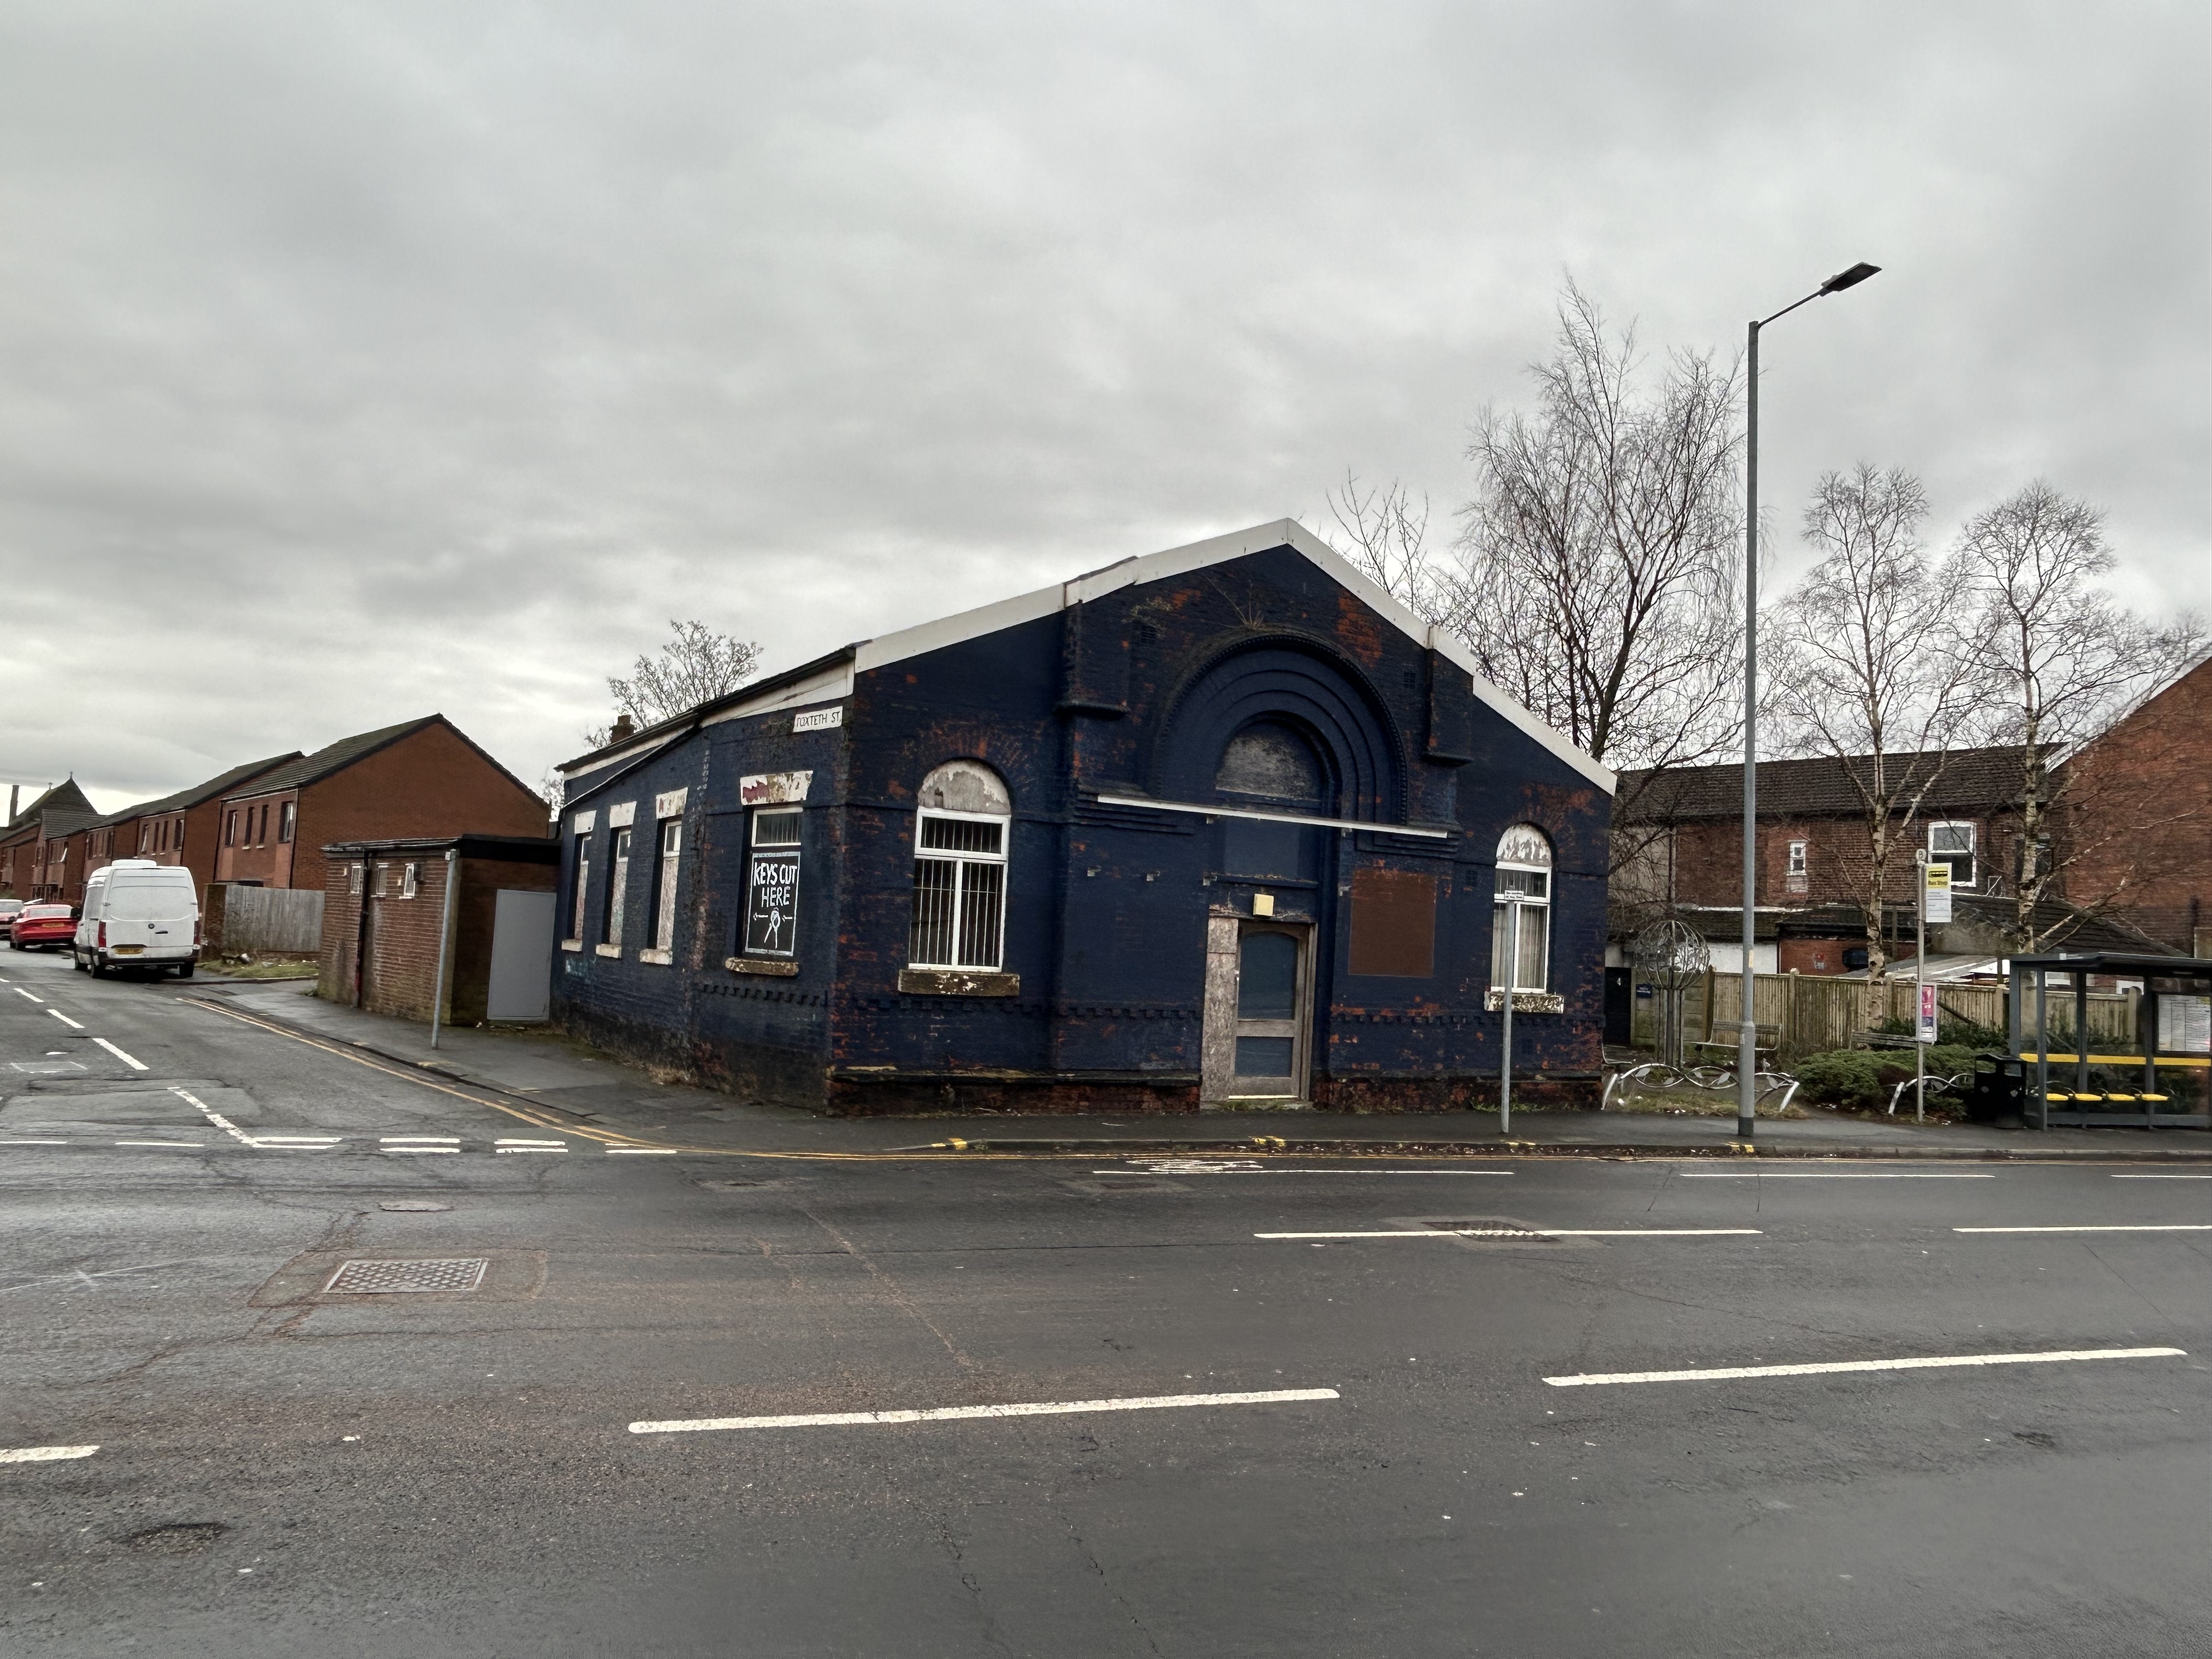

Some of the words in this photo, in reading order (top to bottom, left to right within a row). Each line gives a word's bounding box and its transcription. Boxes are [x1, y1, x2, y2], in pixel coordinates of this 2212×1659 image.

[753, 862, 778, 887] KEYS
[779, 864, 798, 884] CUT
[761, 886, 791, 907] HERE
